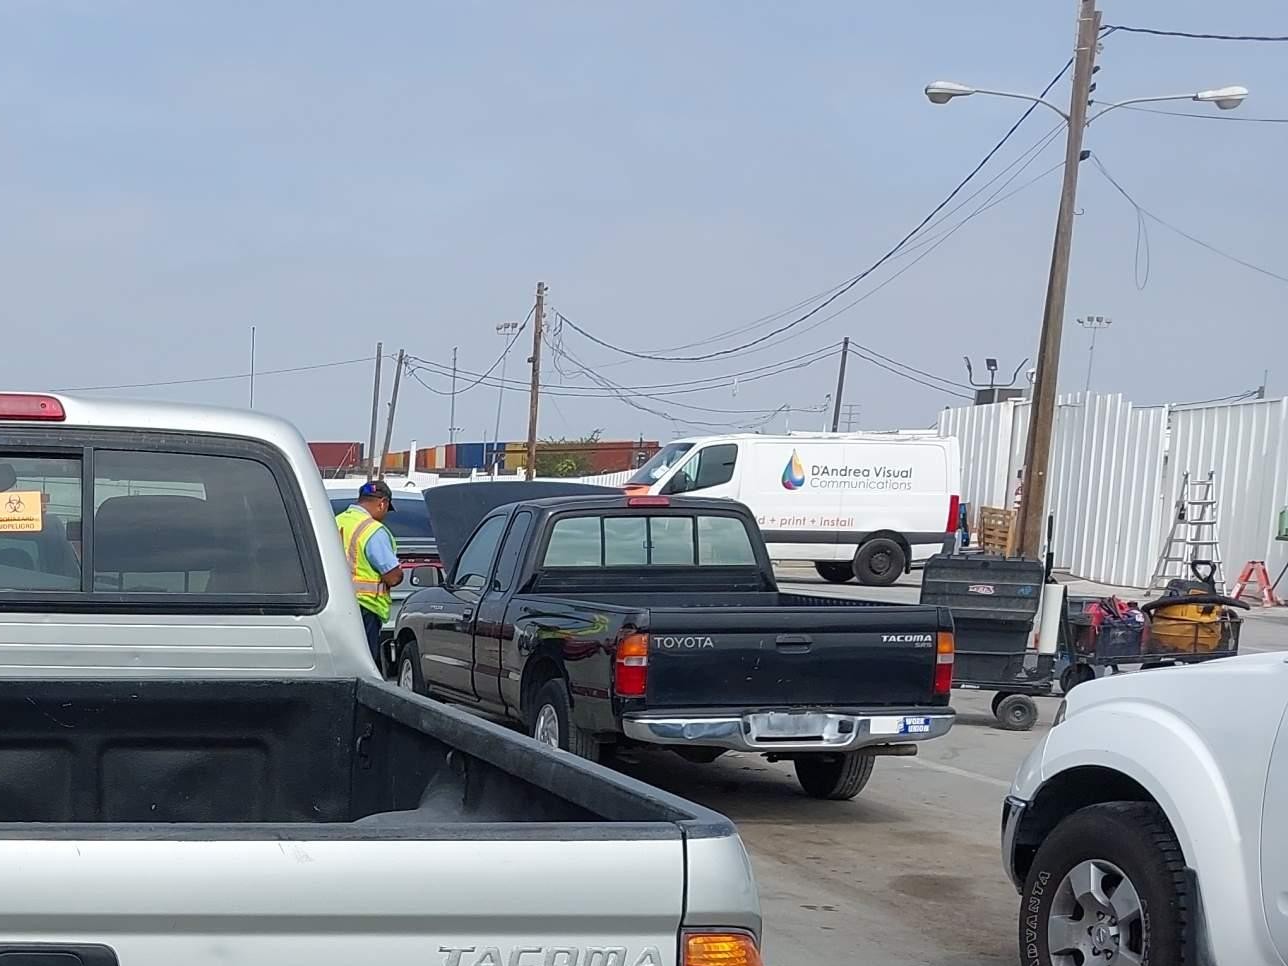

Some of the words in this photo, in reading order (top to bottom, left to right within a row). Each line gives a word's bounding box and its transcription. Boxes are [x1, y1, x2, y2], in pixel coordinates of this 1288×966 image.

[811, 465, 870, 477] D'Andrea
[874, 466, 913, 479] Visual
[810, 477, 912, 490] Communications
[779, 515, 807, 528] print
[819, 516, 855, 527] install
[653, 636, 714, 649] TOYOTA
